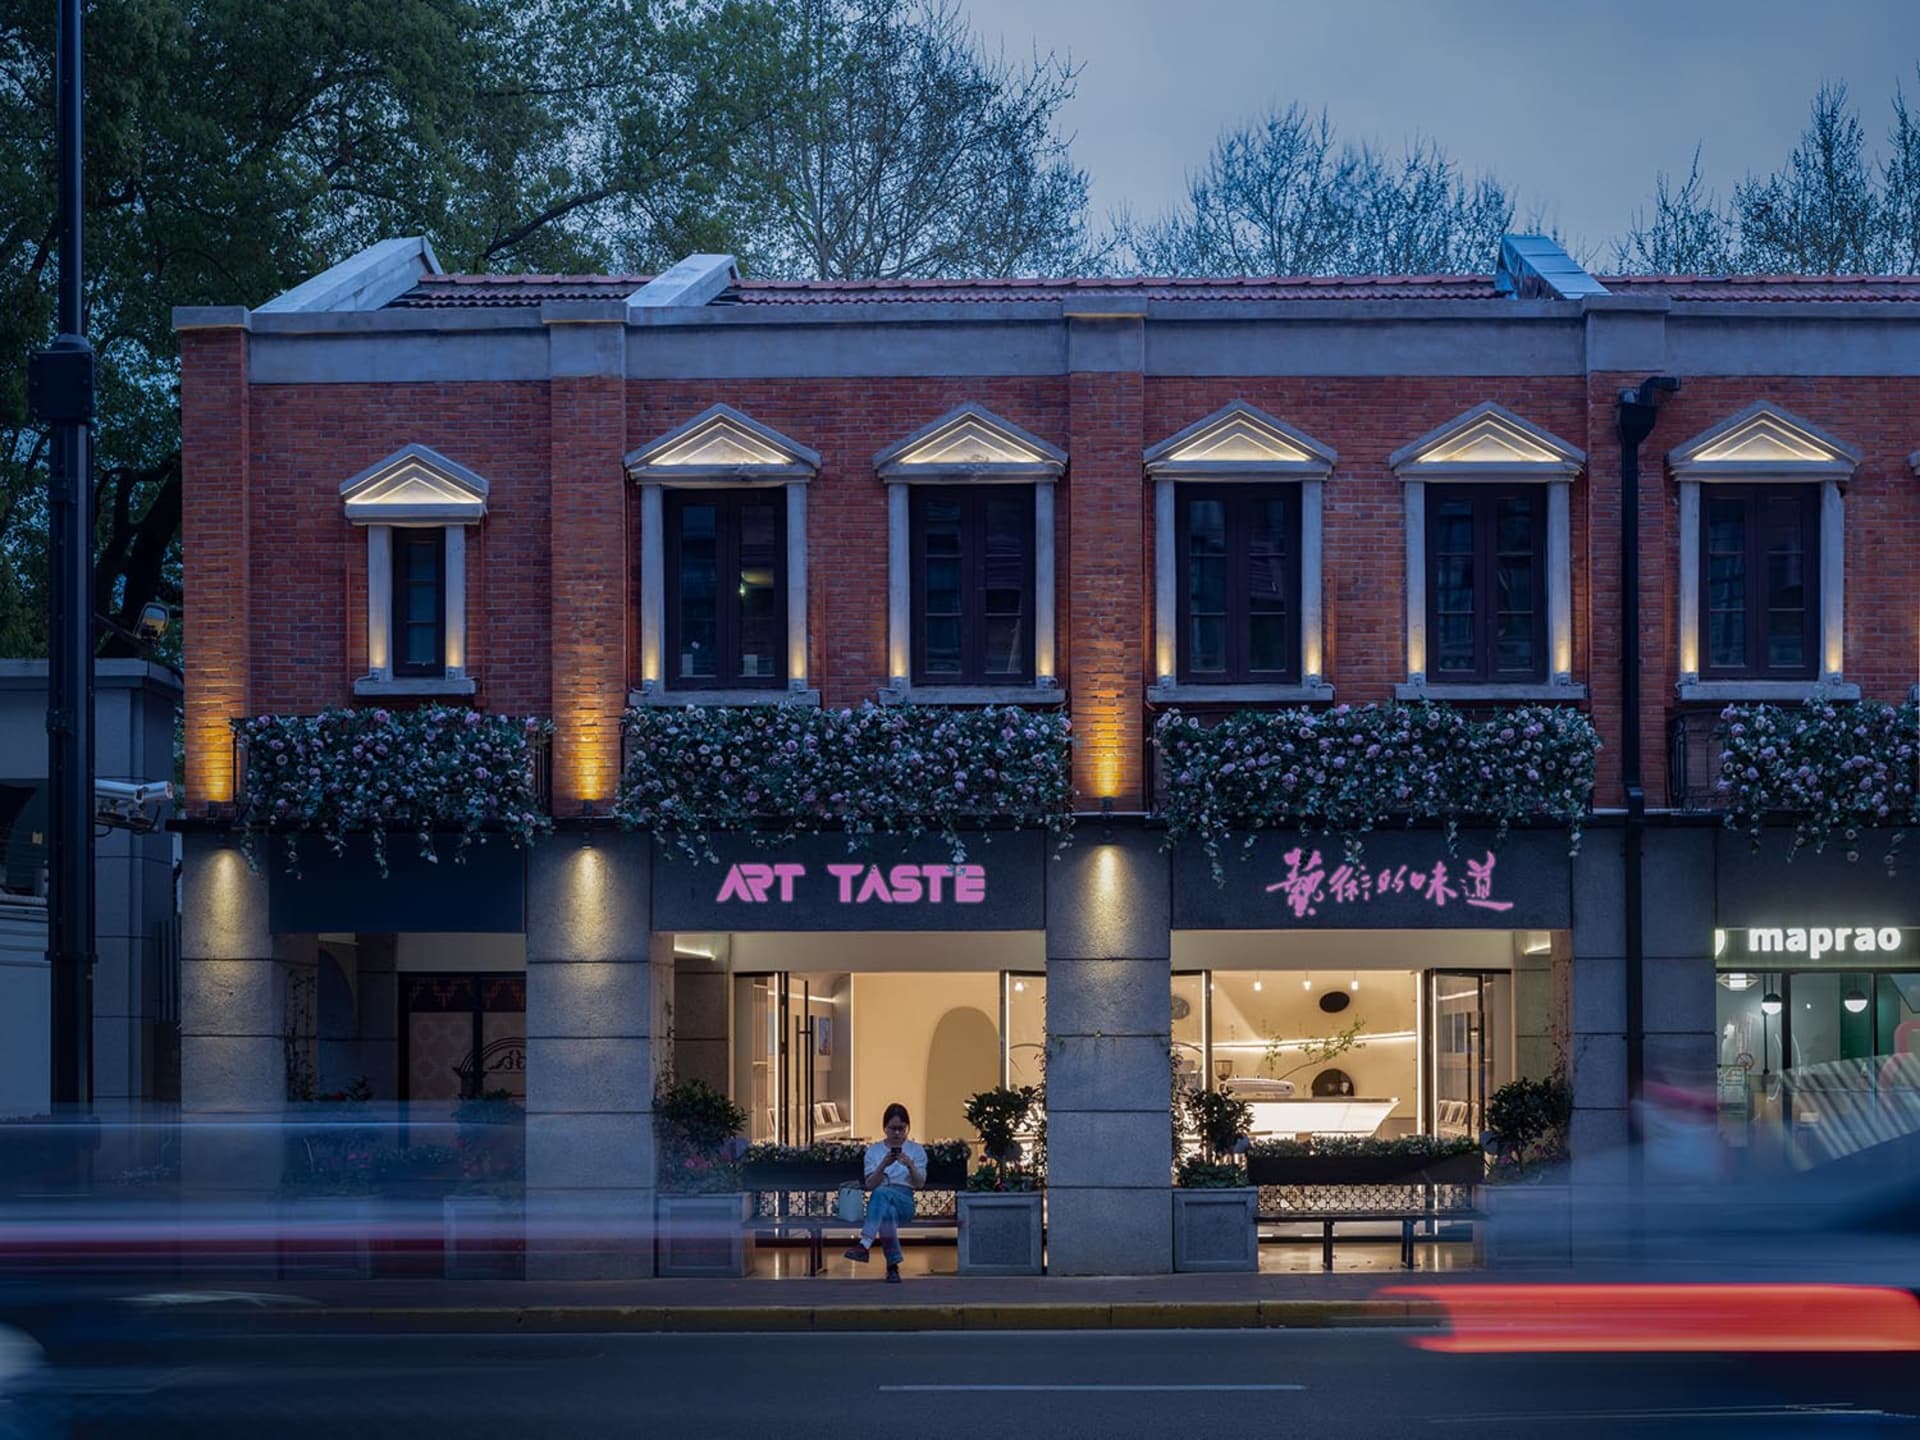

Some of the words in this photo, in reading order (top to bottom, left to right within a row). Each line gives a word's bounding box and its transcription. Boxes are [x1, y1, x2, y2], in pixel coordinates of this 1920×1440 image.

[717, 864, 806, 902] ART
[827, 864, 986, 903] TASTE
[1749, 927, 1902, 959] maprao
